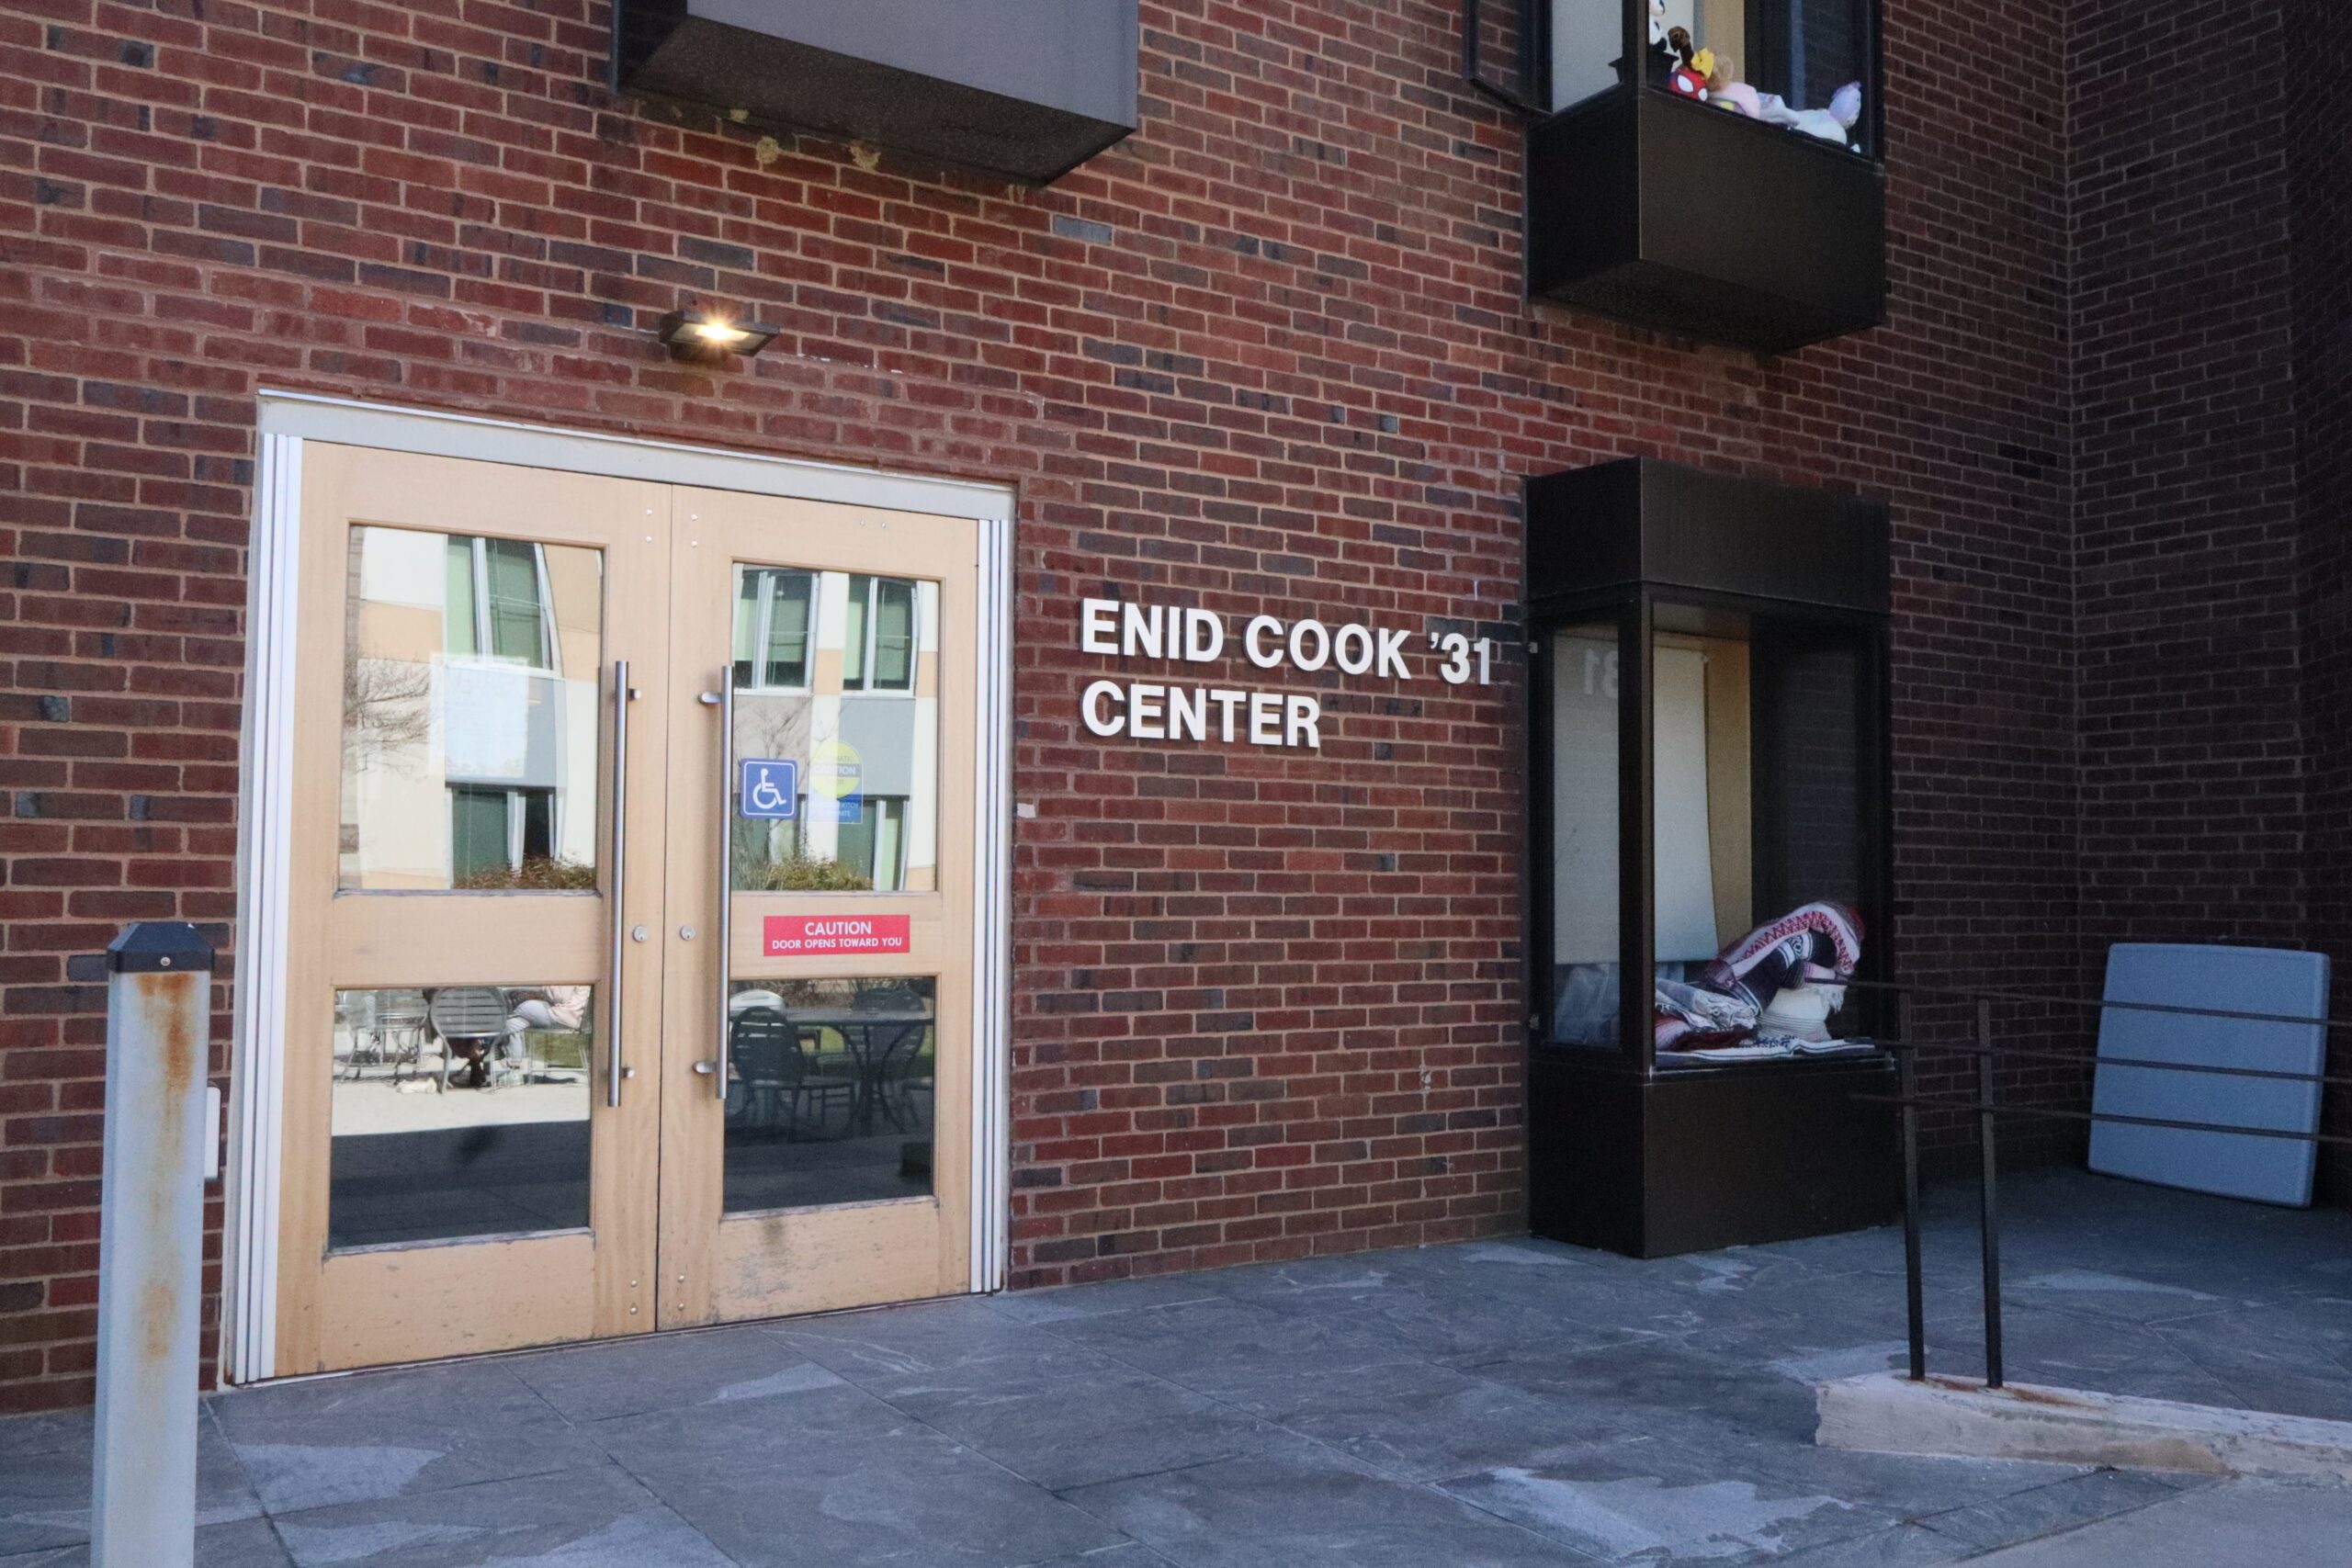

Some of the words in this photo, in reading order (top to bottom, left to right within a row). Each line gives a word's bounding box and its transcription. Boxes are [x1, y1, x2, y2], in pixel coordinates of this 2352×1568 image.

[1082, 598, 1224, 662] ENID
[1244, 615, 1411, 680] COOK
[1430, 632, 1491, 685] '31
[1081, 680, 1321, 749] CENTER
[772, 940, 802, 950] DOOR
[805, 938, 836, 949] OPENS
[839, 937, 879, 948] TOWARD
[881, 937, 902, 947] YOU
[805, 921, 872, 936] CAUTION
